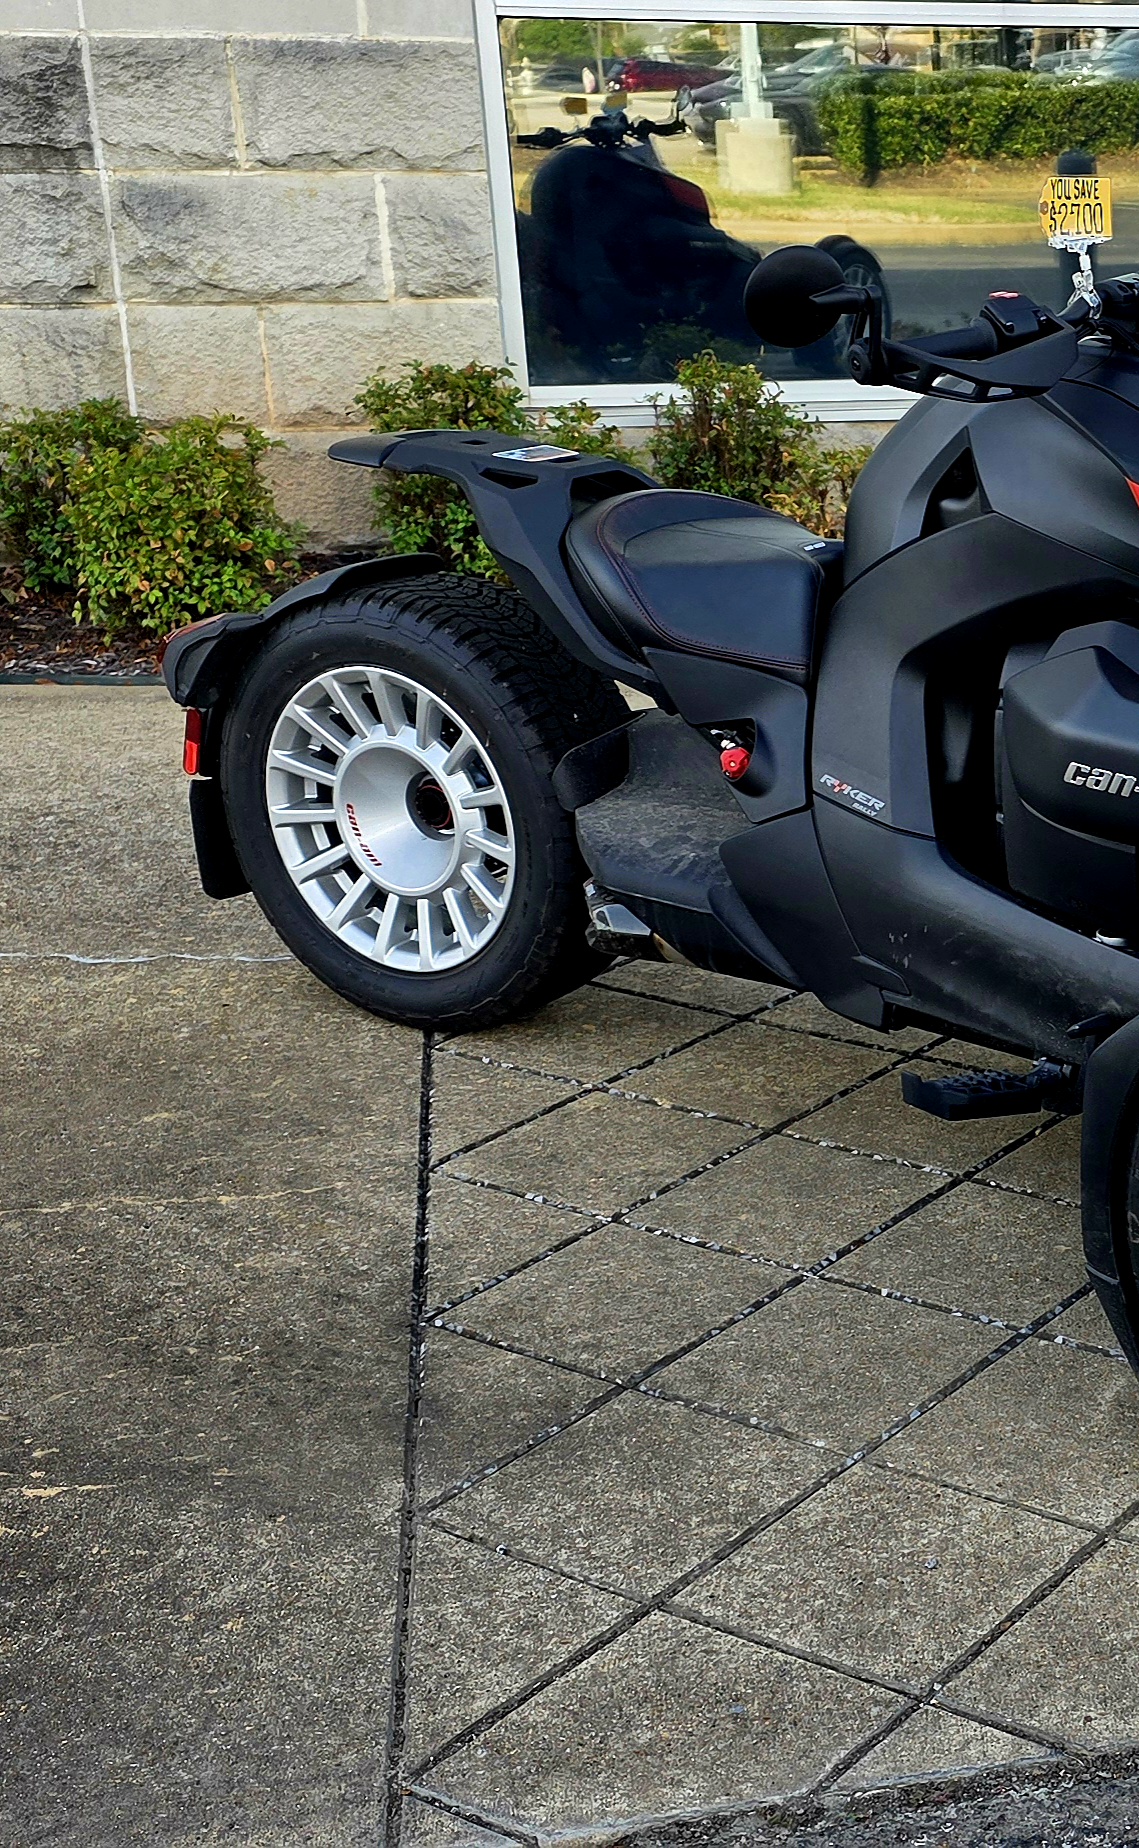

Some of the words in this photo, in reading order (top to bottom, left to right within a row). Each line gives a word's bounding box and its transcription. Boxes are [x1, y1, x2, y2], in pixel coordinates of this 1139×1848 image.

[1050, 178, 1071, 200] YOU
[1073, 178, 1100, 200] SAVE
[1049, 200, 1104, 236] $2700
[820, 774, 886, 811] RYKER
